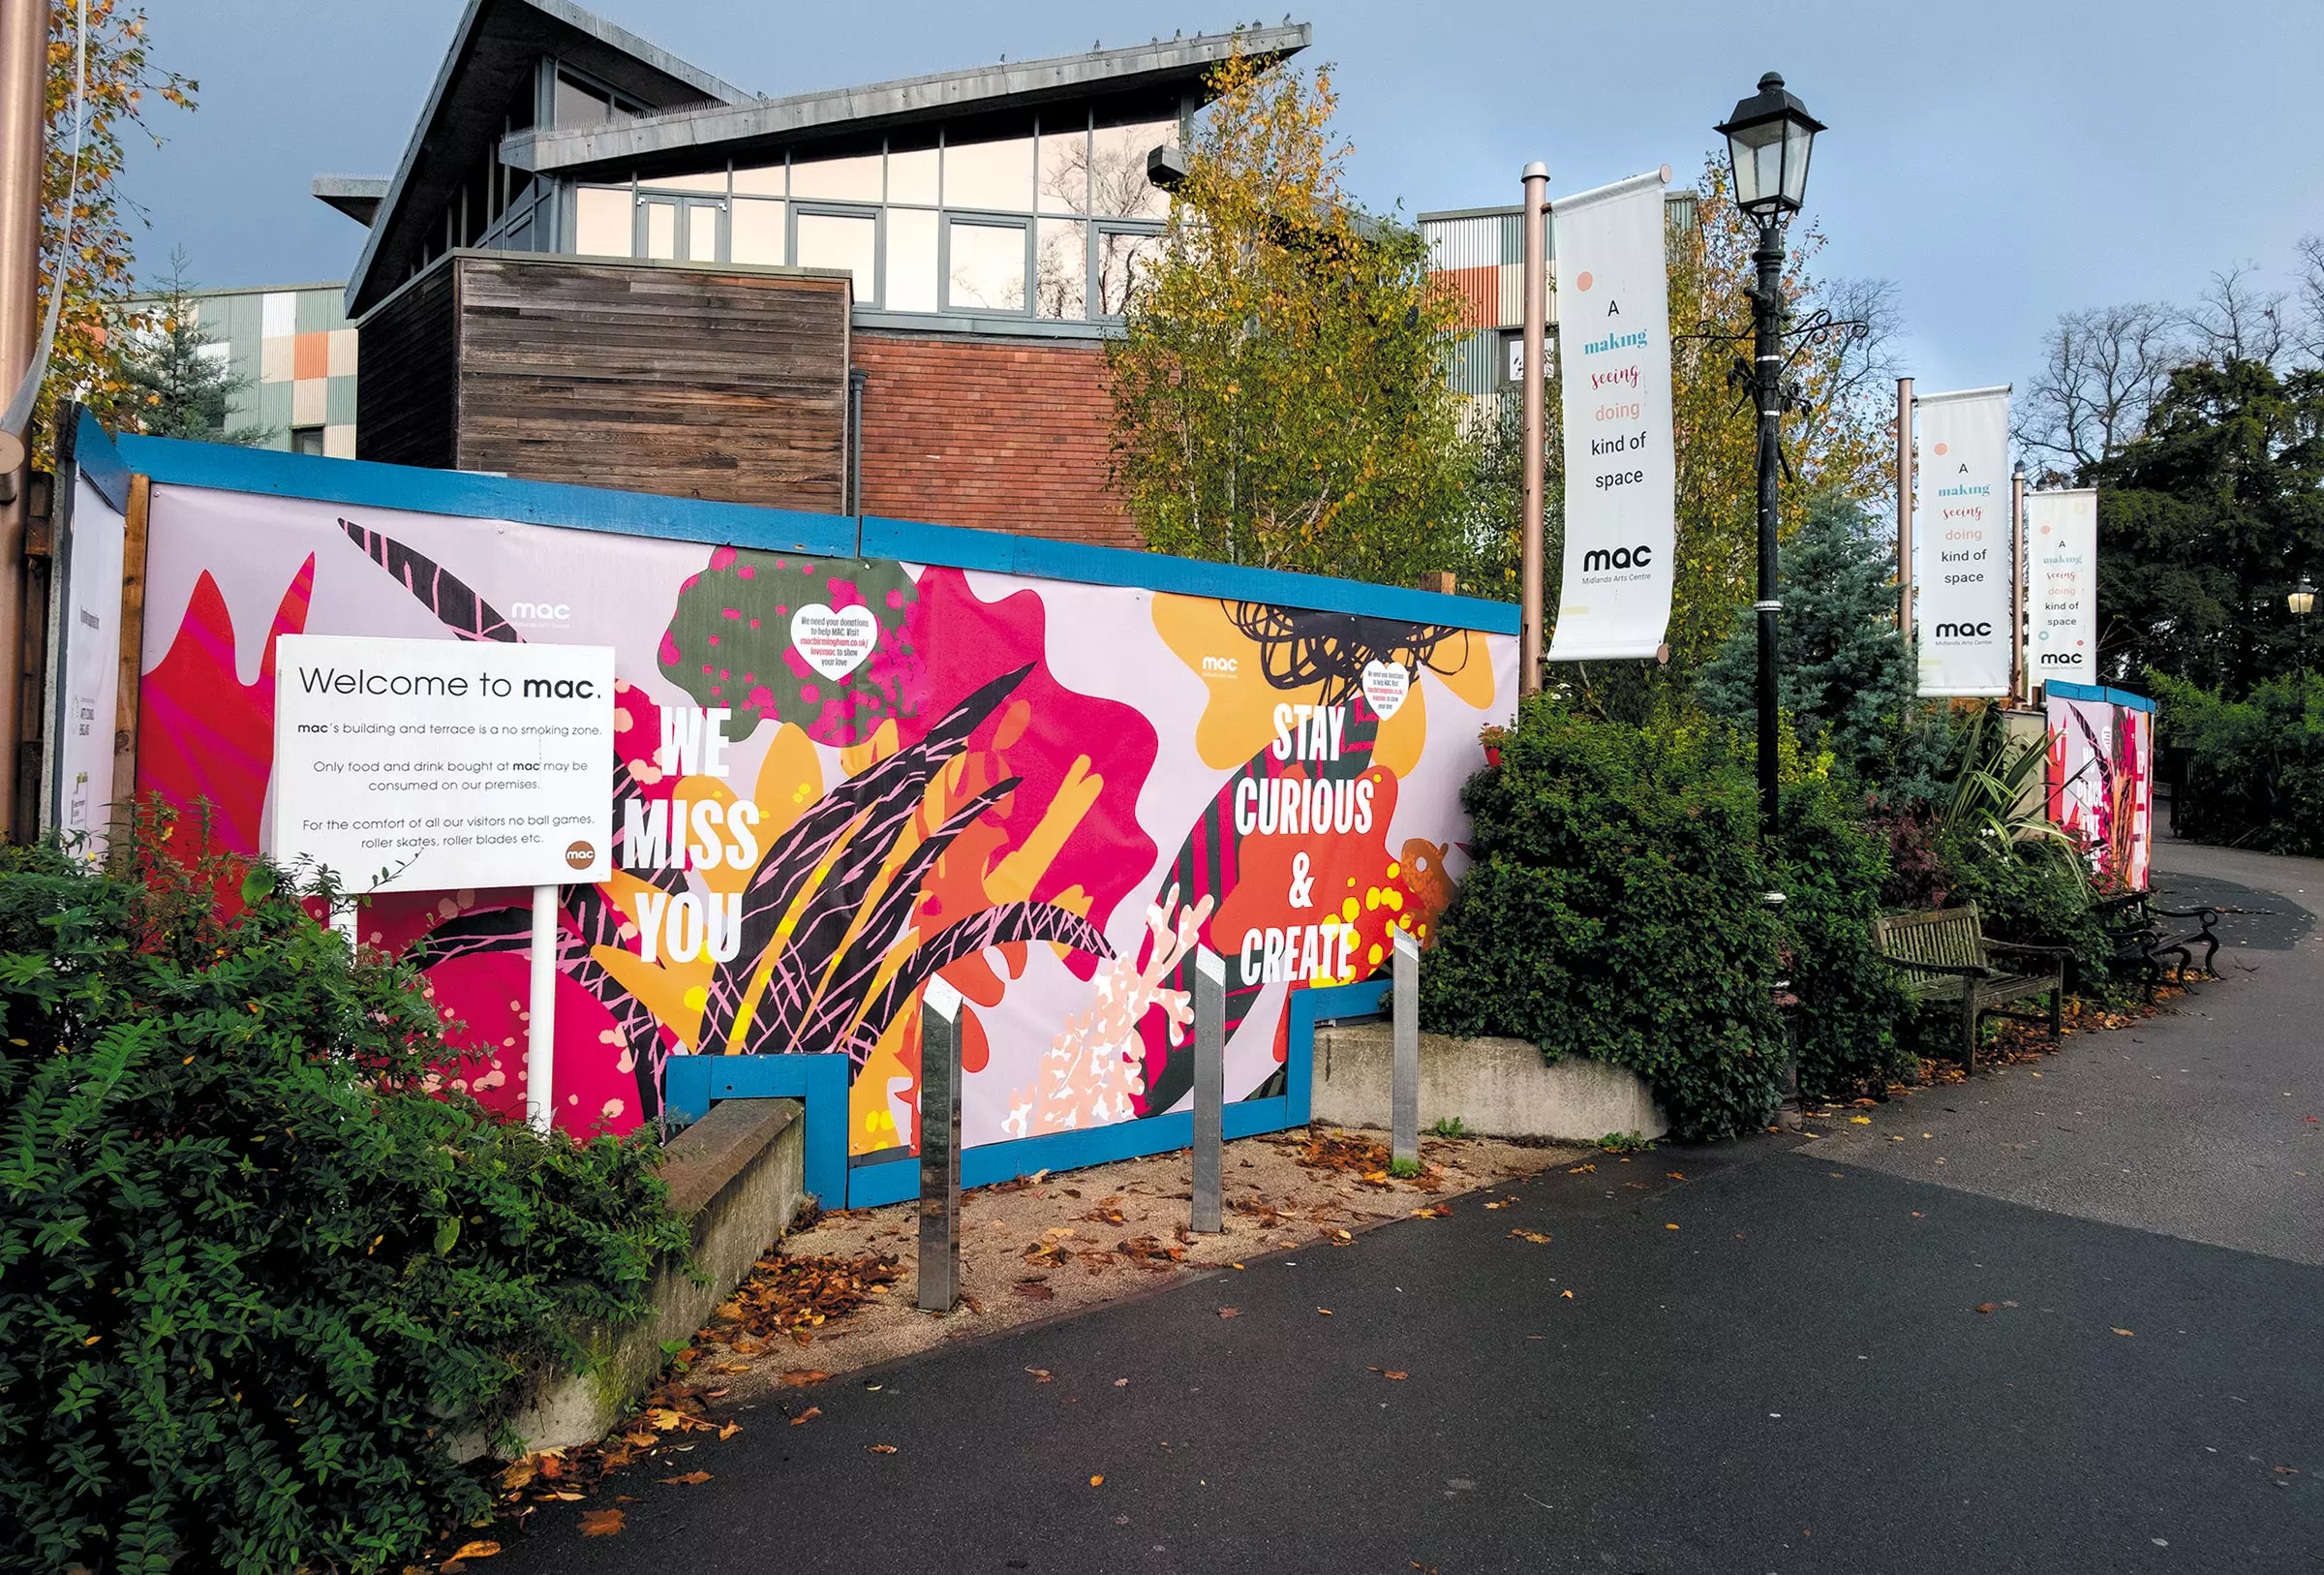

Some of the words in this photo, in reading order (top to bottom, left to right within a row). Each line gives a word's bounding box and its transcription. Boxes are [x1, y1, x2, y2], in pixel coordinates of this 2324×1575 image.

[1607, 299, 1620, 317] A
[1584, 328, 1648, 355] making
[1591, 365, 1640, 390] seeing
[1596, 403, 1639, 421] doing
[1591, 435, 1624, 455] kind
[1630, 431, 1646, 449] of
[1958, 463, 1969, 474] A
[1596, 470, 1643, 491] space
[1938, 484, 1991, 497] making
[1942, 506, 1982, 521] seeing
[1945, 529, 1982, 541] doing
[2059, 540, 2066, 548] A
[1583, 545, 1652, 571] mac
[1942, 550, 1969, 562] kind
[1973, 548, 1987, 561] of
[1629, 572, 1652, 581] Centre
[1944, 573, 1984, 585] space
[2048, 587, 2076, 596] doing
[511, 602, 570, 620] mac
[2068, 602, 2079, 610] of
[1936, 622, 1992, 637] mac
[2047, 618, 2077, 627] space
[1202, 656, 1238, 672] mac
[2041, 653, 2082, 664] mac
[299, 666, 469, 696] Welcome
[479, 672, 512, 697] to
[523, 677, 601, 699] mac.
[343, 723, 395, 736] building
[399, 724, 426, 734] and
[430, 724, 475, 734] terrace
[478, 725, 487, 734] is
[490, 726, 499, 734] a
[502, 726, 518, 735] no
[521, 726, 569, 737] smoking
[571, 726, 602, 736] zone.
[1272, 702, 1346, 761] STAY
[660, 705, 732, 777] WE
[313, 760, 345, 774] Only
[348, 761, 380, 772] food
[383, 761, 411, 772] and
[413, 761, 444, 772] drink
[447, 761, 493, 774] bought
[497, 761, 509, 771] at
[513, 762, 540, 771] mac
[543, 762, 569, 772] may
[572, 761, 588, 771] be
[368, 781, 438, 790] consumed
[442, 782, 458, 790] on
[461, 781, 482, 790] our
[485, 779, 540, 791] premises.
[1235, 777, 1374, 836] CURIOUS
[303, 819, 322, 830] For
[326, 819, 349, 830] the
[352, 818, 405, 829] comfort
[409, 818, 422, 828] of
[426, 818, 440, 828] all
[443, 818, 464, 827] our
[467, 817, 505, 827] visitors
[508, 817, 525, 826] no
[528, 816, 550, 825] ball
[361, 838, 393, 849] roller
[443, 835, 473, 846] roller
[476, 834, 518, 845] blades
[521, 833, 544, 844] etc.
[623, 798, 759, 871] MISS
[566, 850, 595, 860] mac
[1288, 851, 1315, 909] &
[634, 892, 743, 963] YOU
[1239, 922, 1355, 986] CREATE
